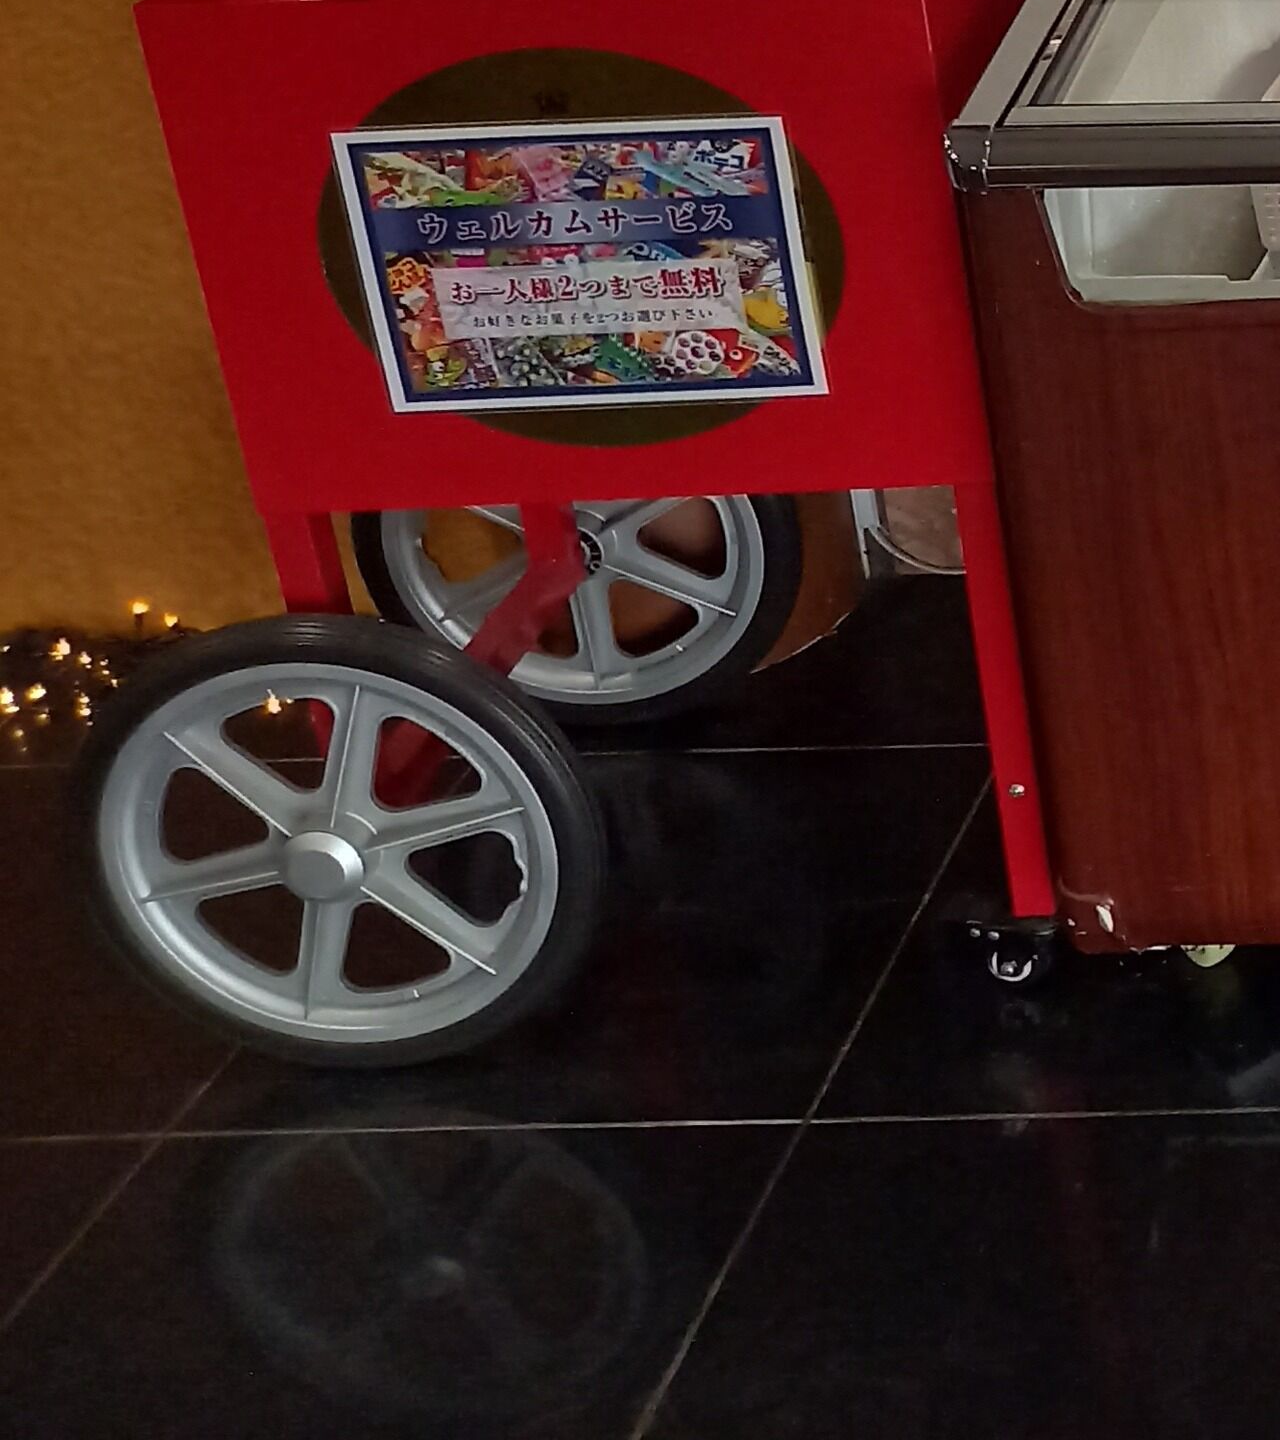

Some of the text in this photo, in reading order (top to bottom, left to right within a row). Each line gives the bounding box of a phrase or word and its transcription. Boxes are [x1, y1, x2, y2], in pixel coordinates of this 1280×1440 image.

[416, 202, 734, 244] ウェルカムサービス
[450, 266, 724, 305] お一人様2つまで無料
